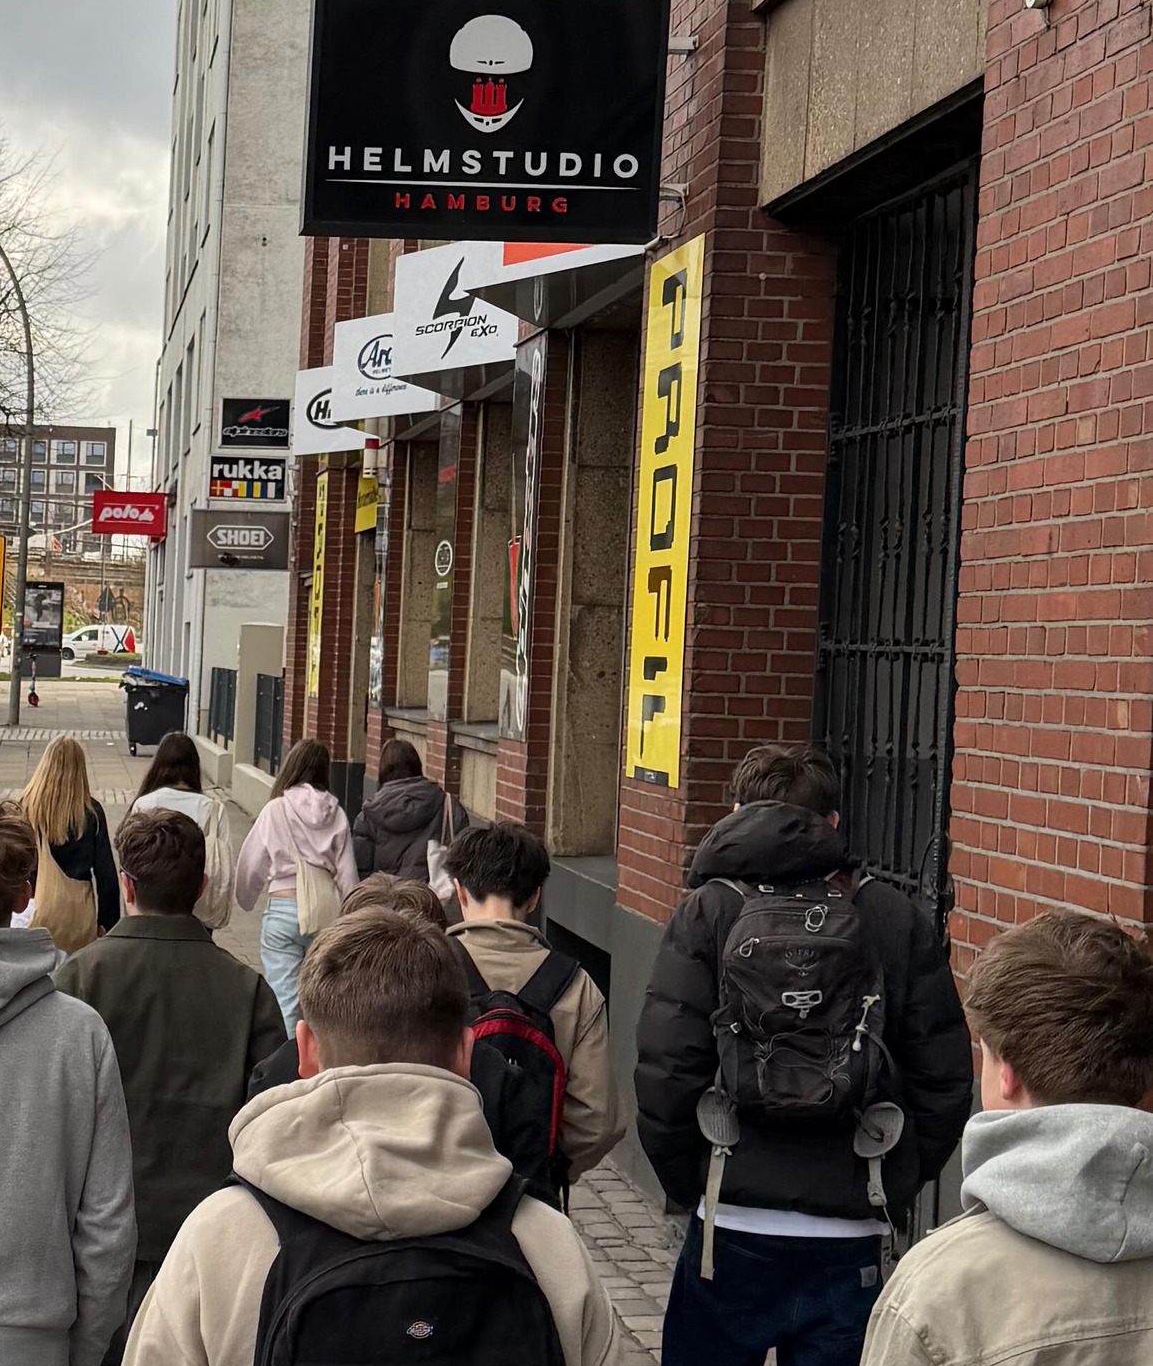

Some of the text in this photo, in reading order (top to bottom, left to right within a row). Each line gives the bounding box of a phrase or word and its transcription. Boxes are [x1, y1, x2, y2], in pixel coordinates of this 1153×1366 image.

[328, 145, 640, 179] HELMSTUDIO
[395, 192, 568, 213] HAMBURG
[415, 314, 488, 336] SCORPION
[212, 460, 283, 480] rukka
[98, 503, 140, 522] polo
[216, 529, 266, 546] SHOEI
